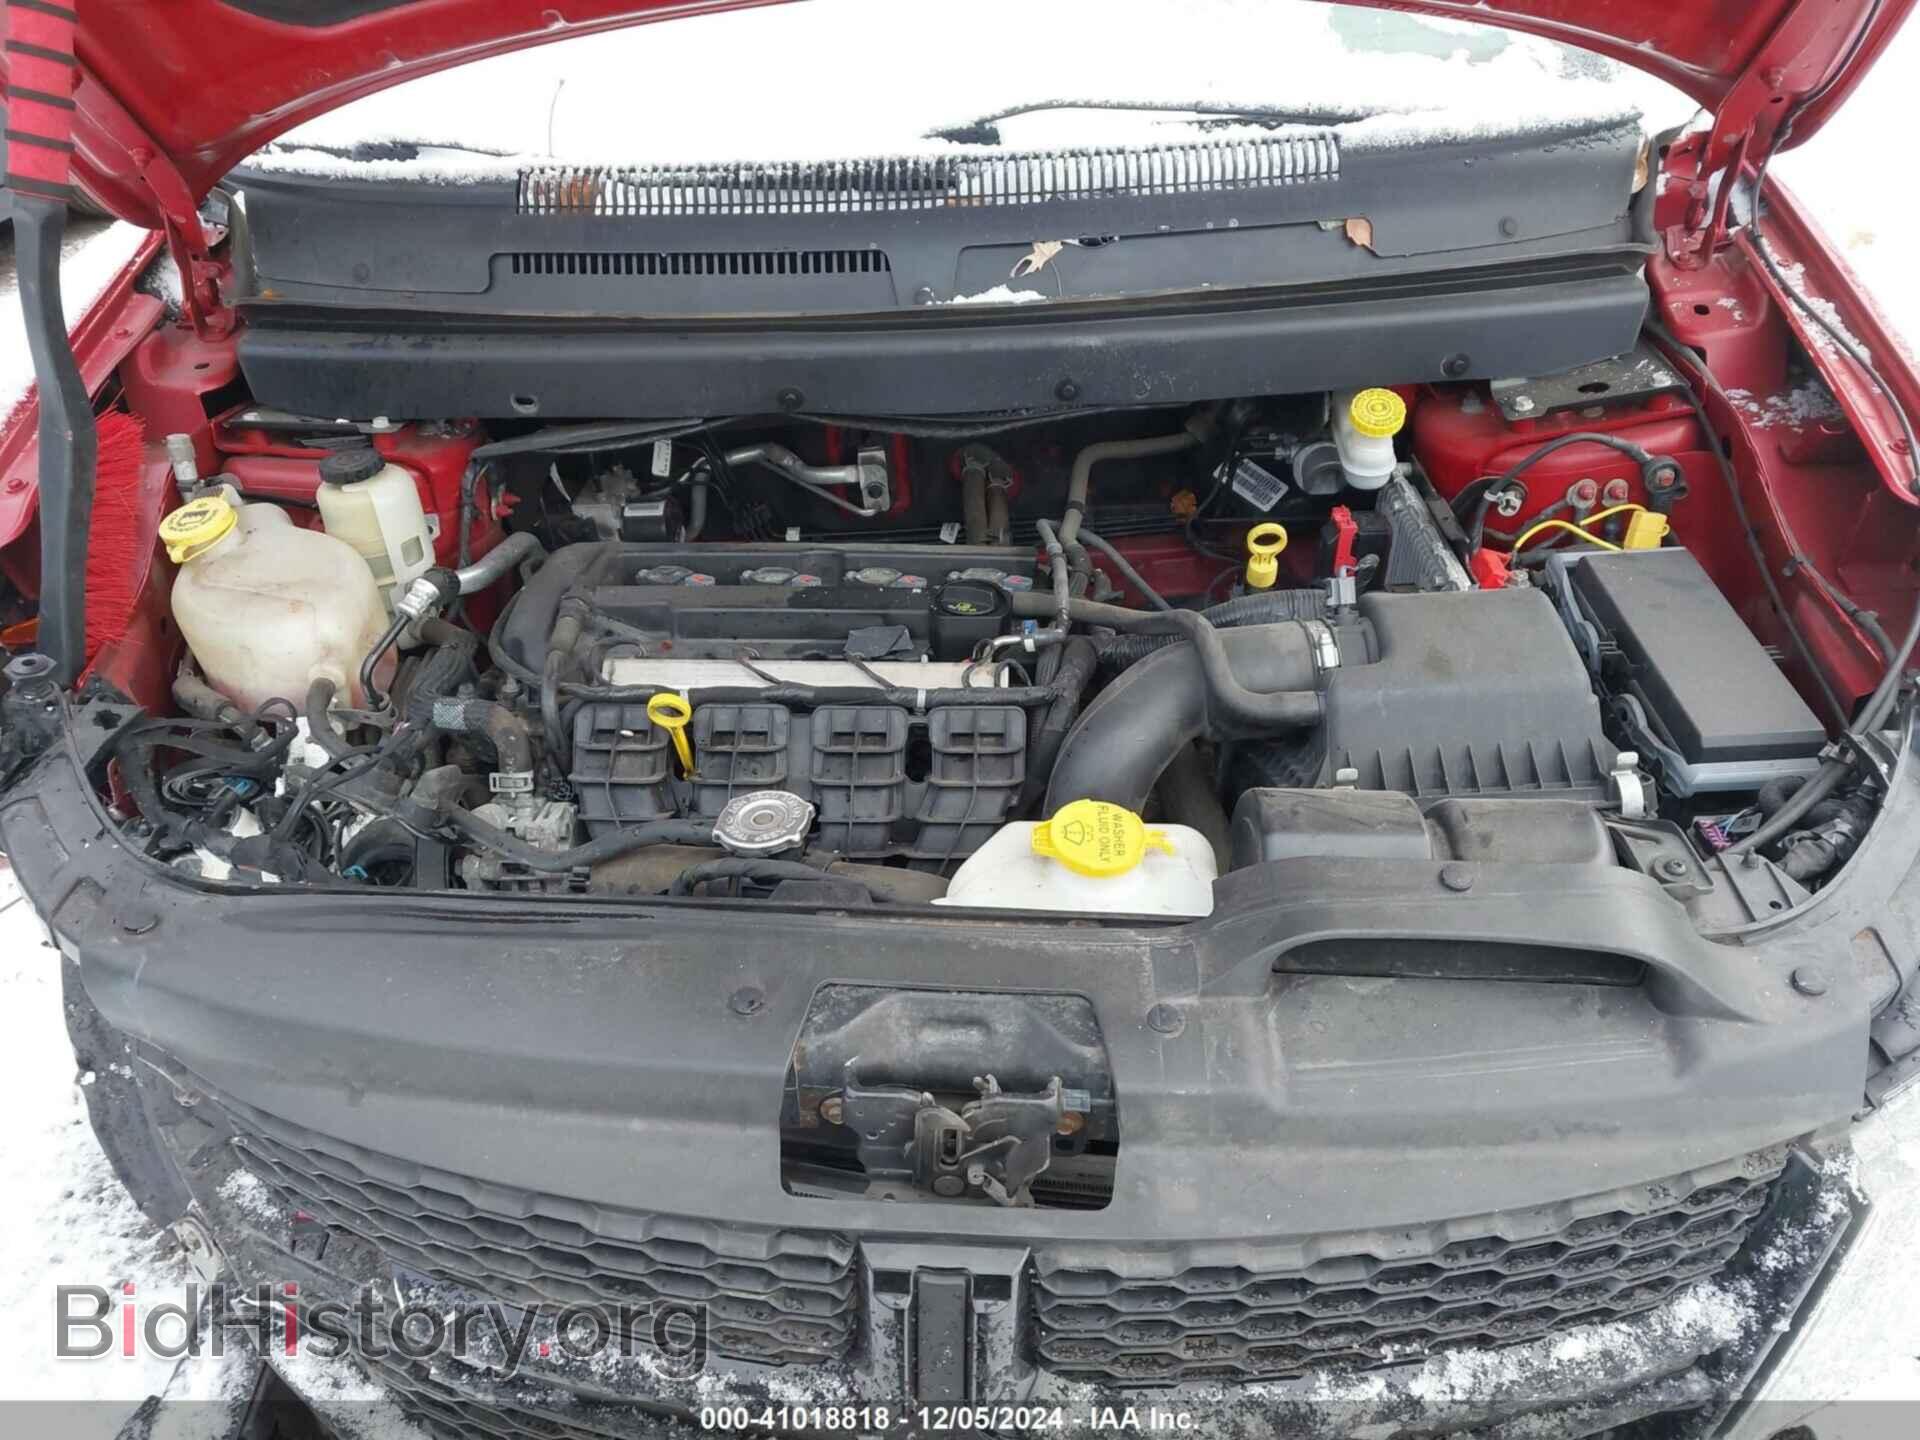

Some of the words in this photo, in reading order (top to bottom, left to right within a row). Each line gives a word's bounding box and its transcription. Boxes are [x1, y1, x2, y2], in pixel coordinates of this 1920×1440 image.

[1098, 805, 1109, 835] FLUID
[1113, 812, 1126, 857] WASHER
[1099, 838, 1112, 863] ONLY
